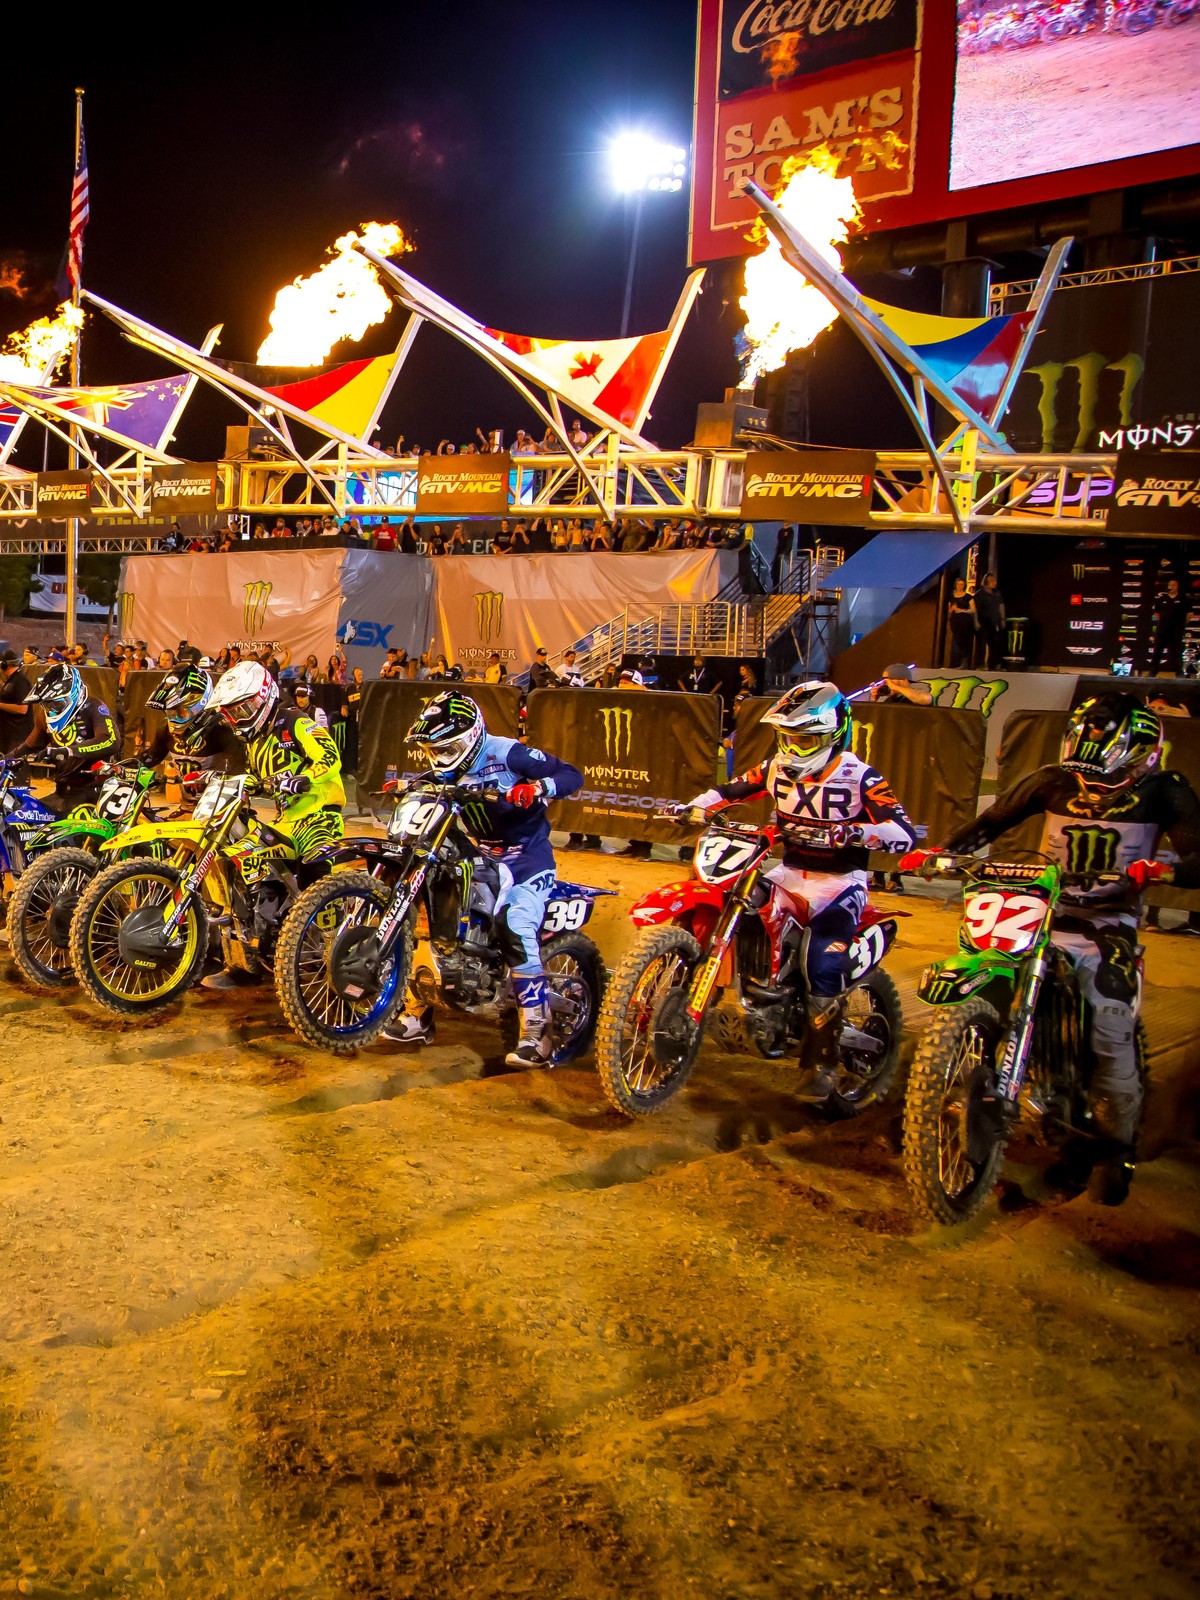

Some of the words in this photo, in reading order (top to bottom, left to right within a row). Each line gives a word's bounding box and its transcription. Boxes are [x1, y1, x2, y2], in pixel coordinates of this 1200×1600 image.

[725, 87, 904, 161] SAM'S
[724, 141, 904, 200] TON
[432, 473, 458, 481] ROCKY
[458, 472, 502, 481] MOUNTAIN
[765, 473, 801, 483] ROCKY
[803, 472, 864, 483] MOUNTAIN
[1143, 478, 1192, 490] ROCKY
[1070, 620, 1104, 630] WPS
[584, 765, 650, 782] MONSTER
[594, 780, 639, 789] ENERGY
[565, 790, 680, 809] UPERCROS
[610, 809, 648, 820] Championship
[774, 777, 852, 820] FXR
[390, 800, 446, 836] 39
[699, 836, 759, 872] 37
[984, 867, 1046, 877] RENTHA
[162, 903, 181, 935] DUNLOP
[376, 883, 405, 941] DUNLOP
[543, 899, 587, 932] 39
[966, 892, 1048, 941] 92
[849, 924, 886, 980] 37
[998, 1030, 1019, 1096] DUNLOP
